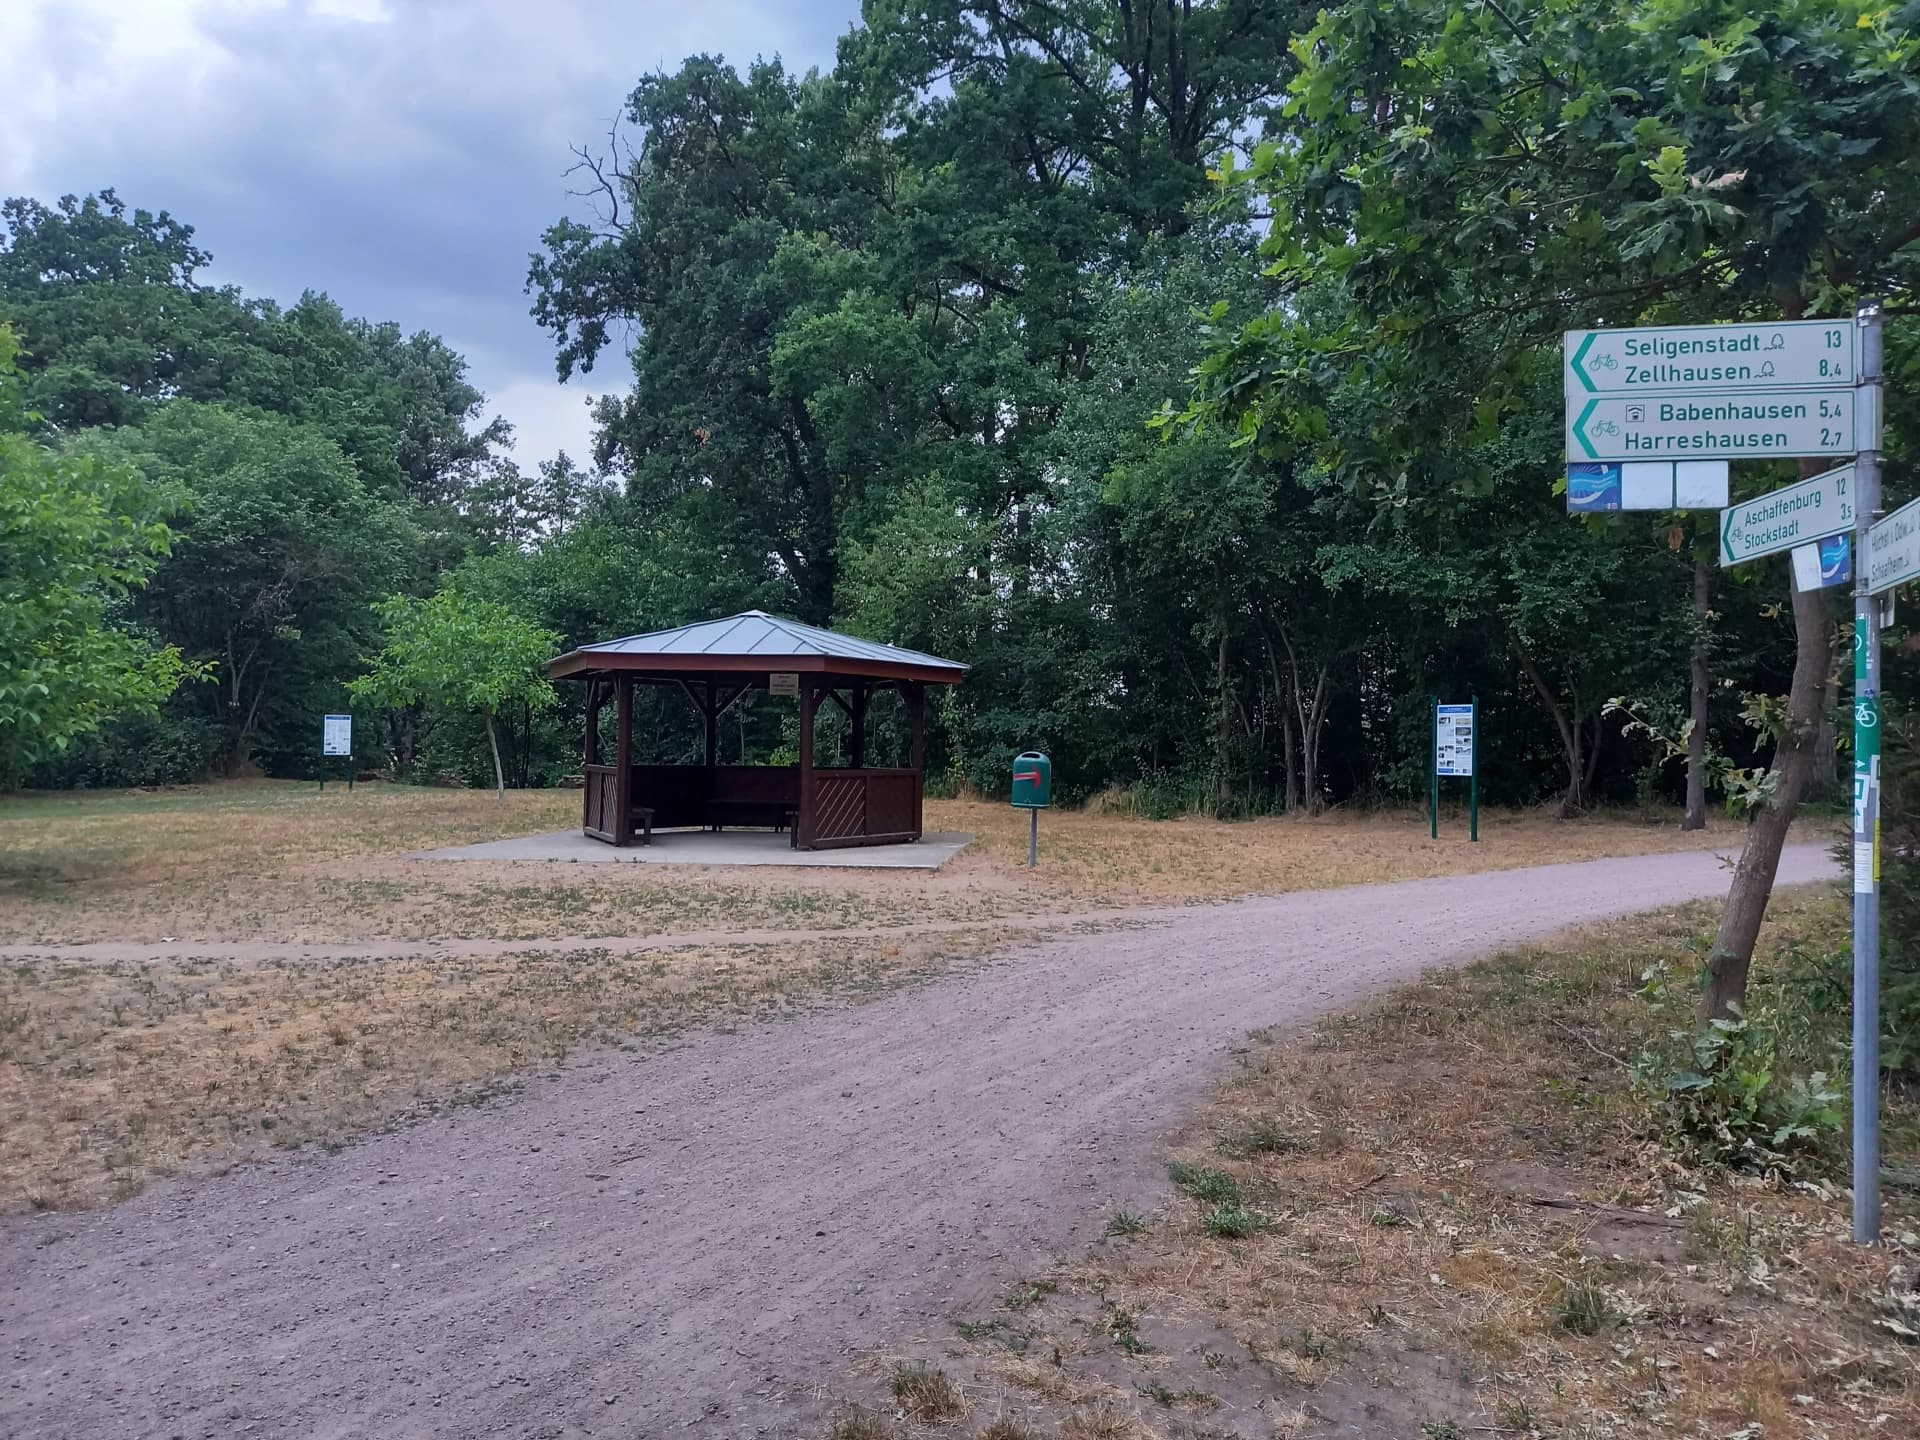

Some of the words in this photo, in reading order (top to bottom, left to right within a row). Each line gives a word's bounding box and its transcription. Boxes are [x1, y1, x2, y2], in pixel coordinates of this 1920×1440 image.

[1624, 334, 1760, 359] Seligenstadt
[1824, 330, 1842, 348] 13
[1625, 364, 1751, 384] Zellhausen
[1819, 359, 1842, 377] 8,4
[1659, 402, 1806, 421] Babenhausen
[1819, 400, 1842, 419] 5,4
[1625, 430, 1788, 450] Harreshausen
[1820, 428, 1842, 447] 2,7
[1744, 490, 1822, 527] Aschaffenburg
[1836, 478, 1847, 496] 12
[1744, 520, 1799, 550] Stockstadt
